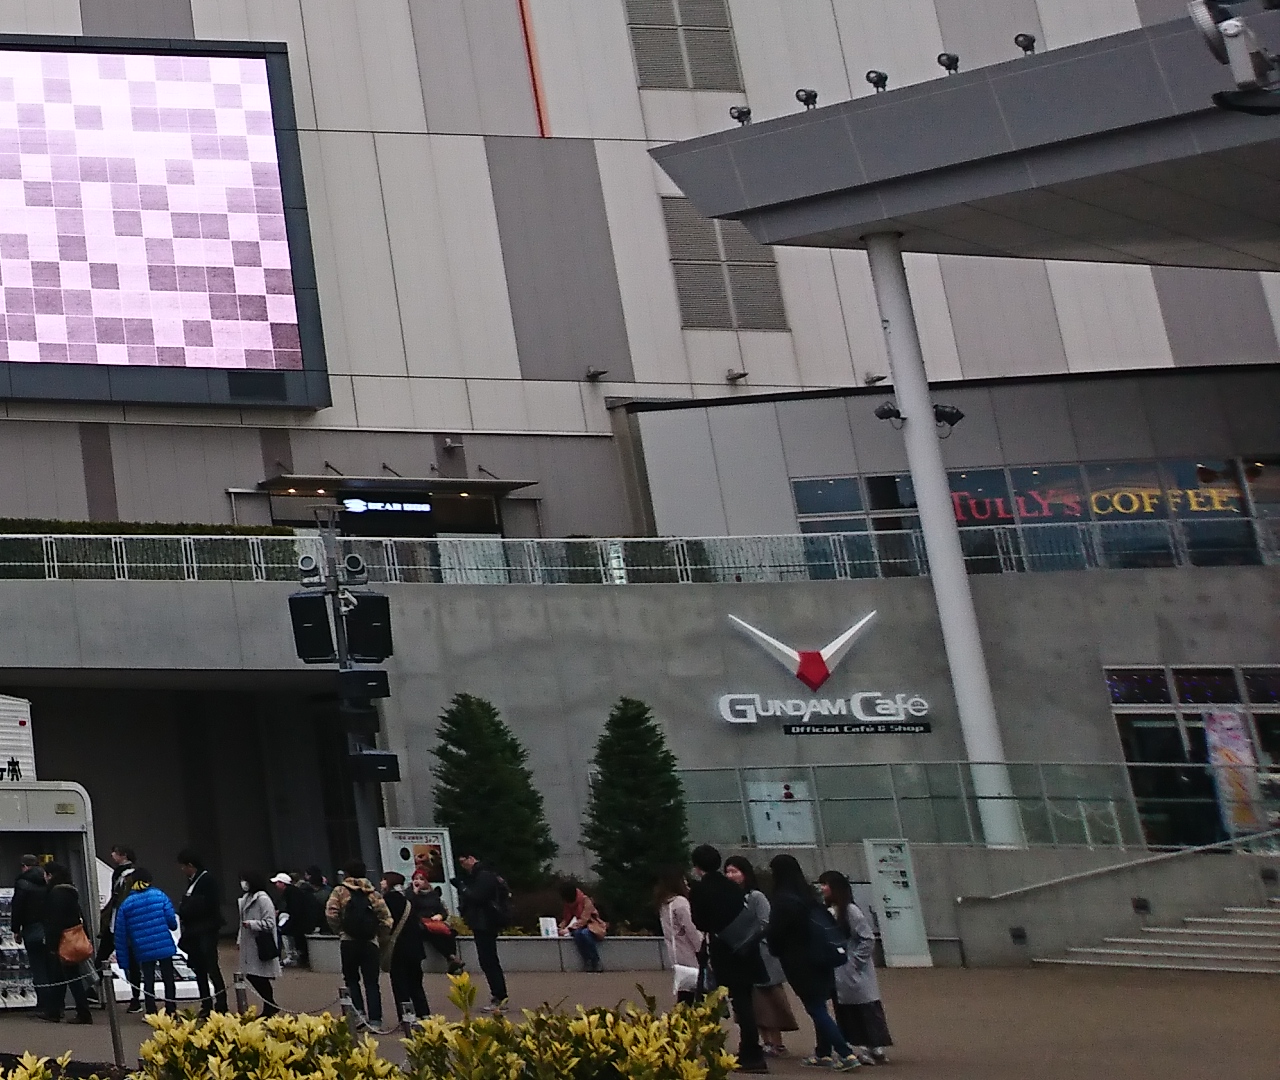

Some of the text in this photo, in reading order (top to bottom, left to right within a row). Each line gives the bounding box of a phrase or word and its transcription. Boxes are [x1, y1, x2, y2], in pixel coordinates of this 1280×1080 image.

[1091, 488, 1237, 515] COFFEE
[790, 725, 840, 733] Official
[889, 724, 925, 733] Shop
